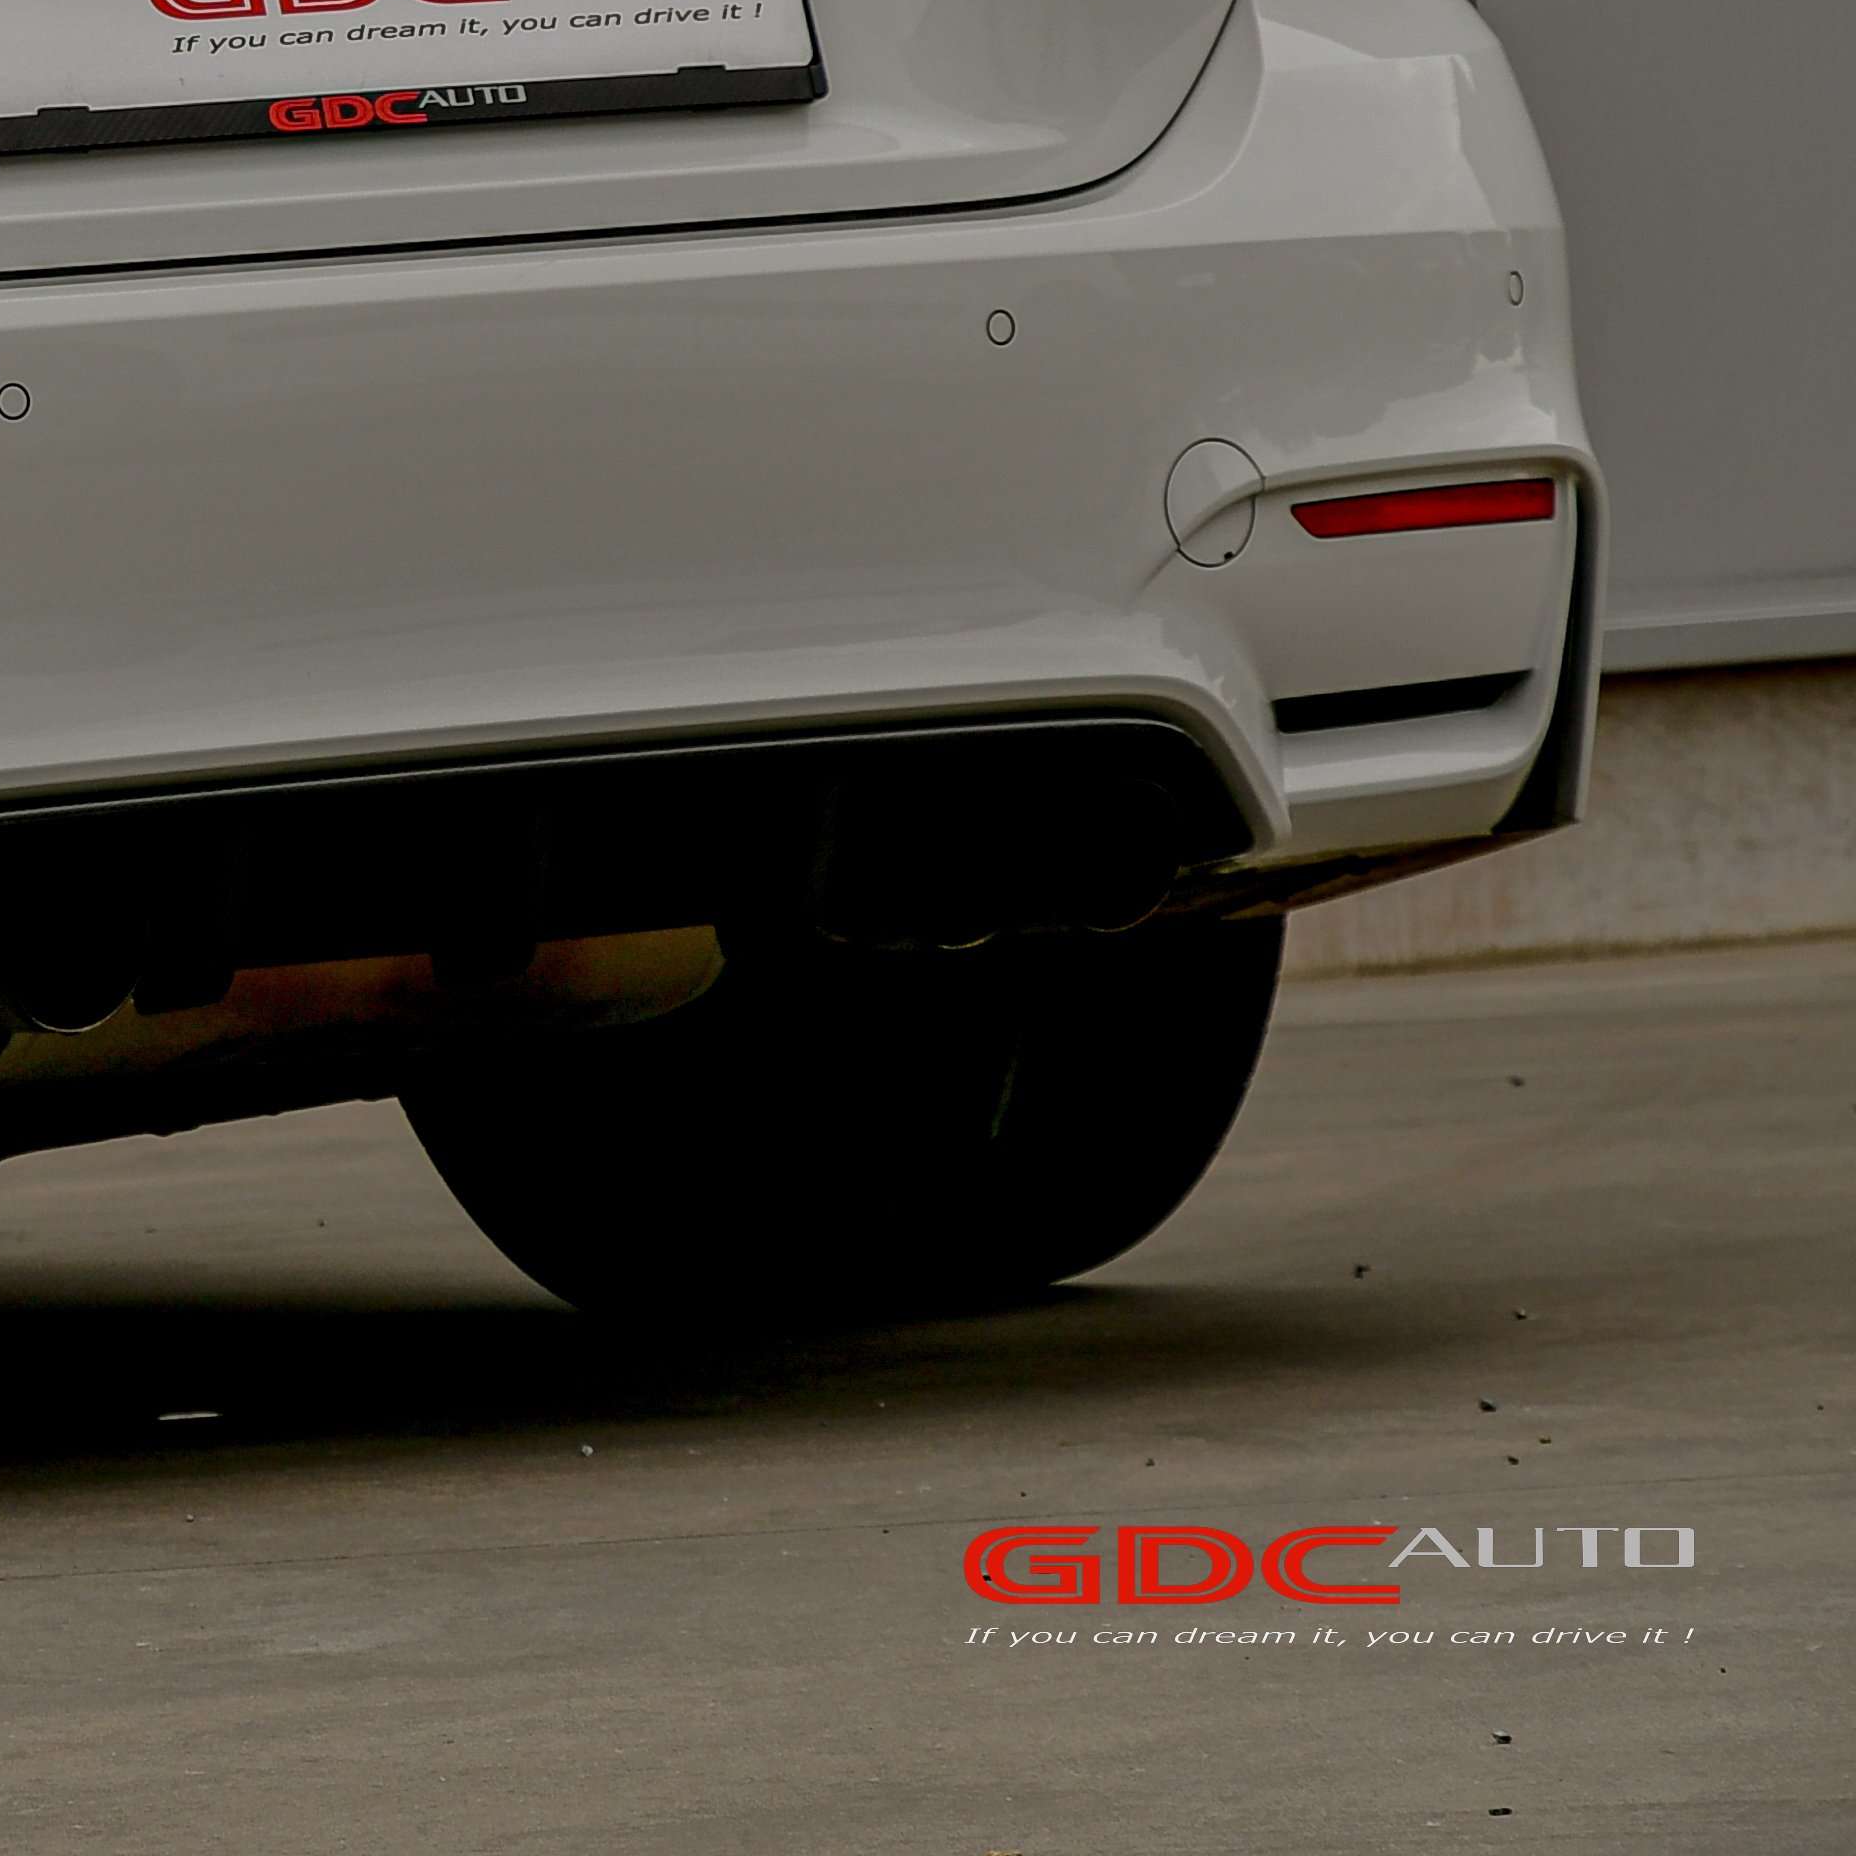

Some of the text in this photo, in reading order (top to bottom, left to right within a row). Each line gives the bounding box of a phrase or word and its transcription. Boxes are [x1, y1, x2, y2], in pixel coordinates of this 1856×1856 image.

[172, 34, 200, 53] If
[210, 33, 266, 54] you
[280, 27, 333, 45] can
[346, 22, 447, 41] dream
[459, 18, 488, 36] it,
[503, 15, 556, 34] you
[569, 10, 621, 28] can
[634, 5, 710, 25] drive
[722, 3, 742, 20] it
